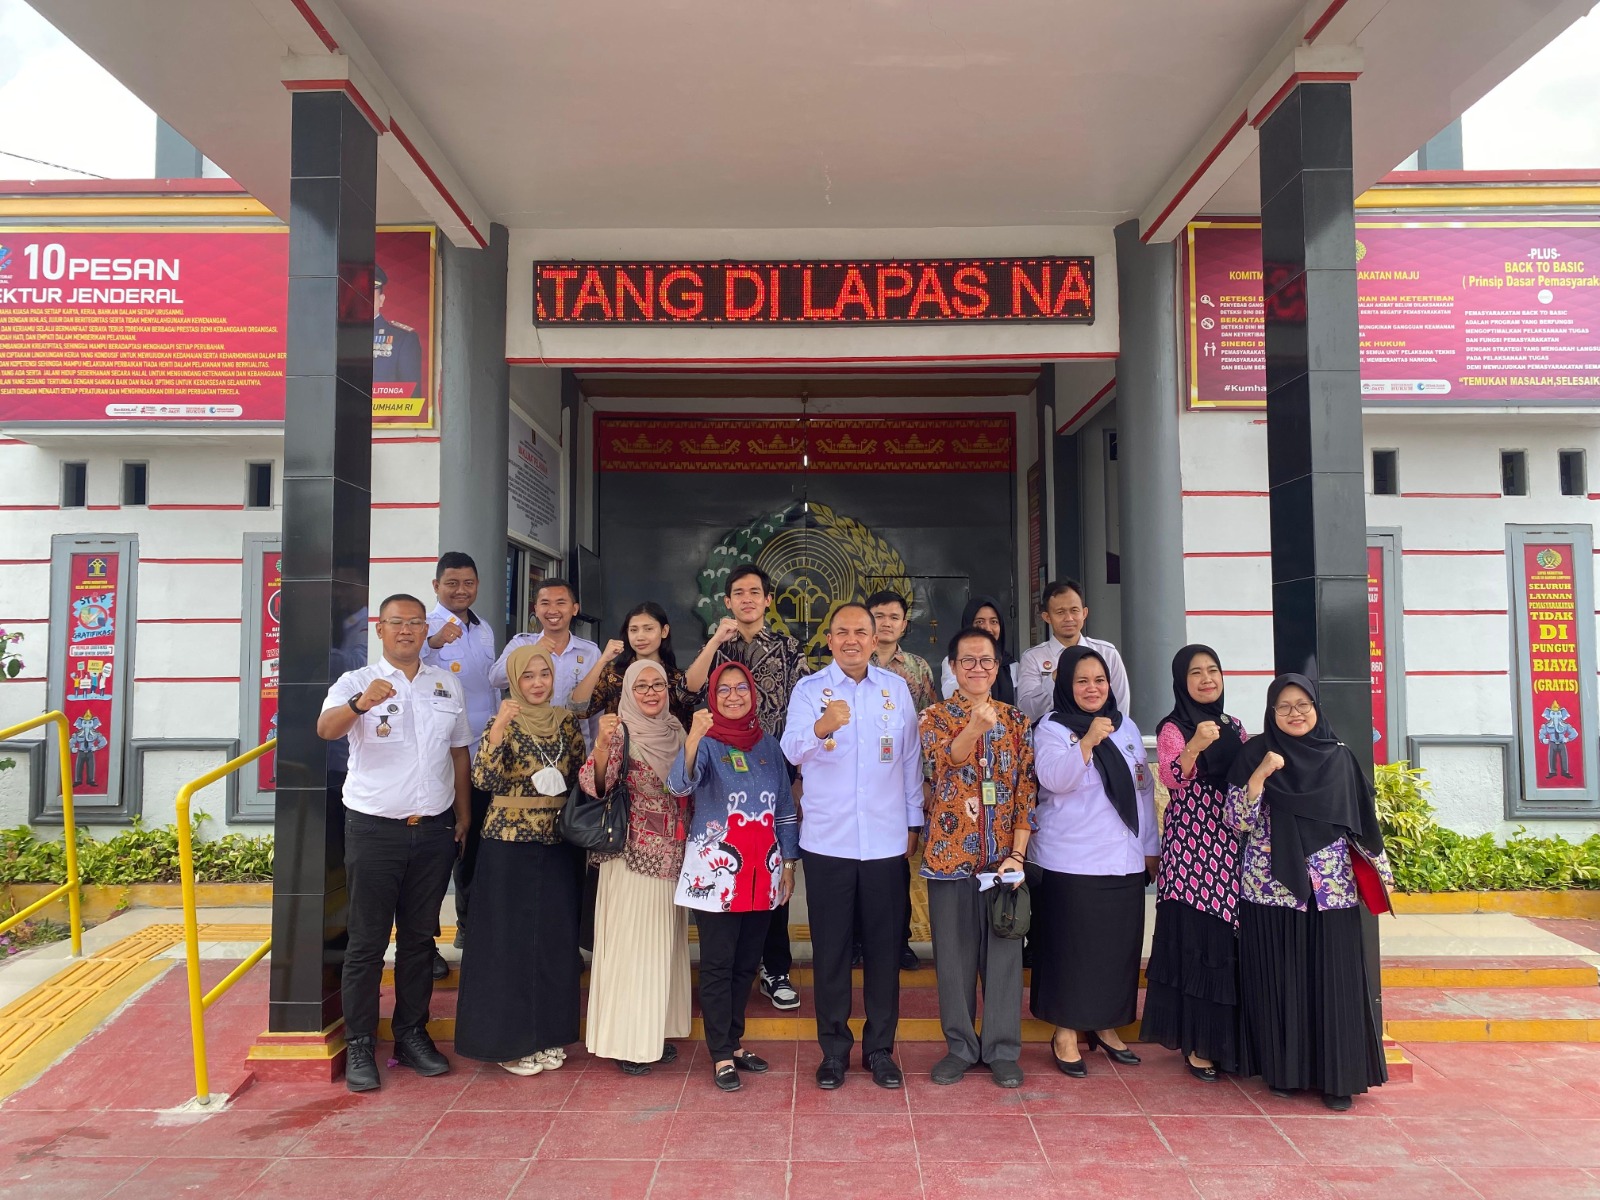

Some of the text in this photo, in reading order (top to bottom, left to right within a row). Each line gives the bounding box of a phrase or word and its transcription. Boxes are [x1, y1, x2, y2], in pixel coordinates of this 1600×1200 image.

[1527, 248, 1561, 259] -PLUS-
[24, 243, 180, 281] 10 PESAN
[1504, 261, 1585, 273] BACK TO BASIC
[1393, 271, 1420, 280] MAJU
[1469, 275, 1503, 289] Prinsip
[1506, 276, 1535, 287] Dasar
[1538, 275, 1600, 289] Pemasyarak
[0, 287, 184, 304] KTUR JENDERAL
[536, 266, 1090, 319] TANG DI LAPAS NA
[1224, 384, 1267, 392] #Kumha
[404, 403, 413, 411] RI
[1529, 611, 1574, 620] TIDAK
[1539, 624, 1569, 640] DI
[1531, 643, 1576, 653] PUNGUT
[1532, 658, 1578, 672] BIAYA
[1533, 678, 1579, 695] (GRATIS)
